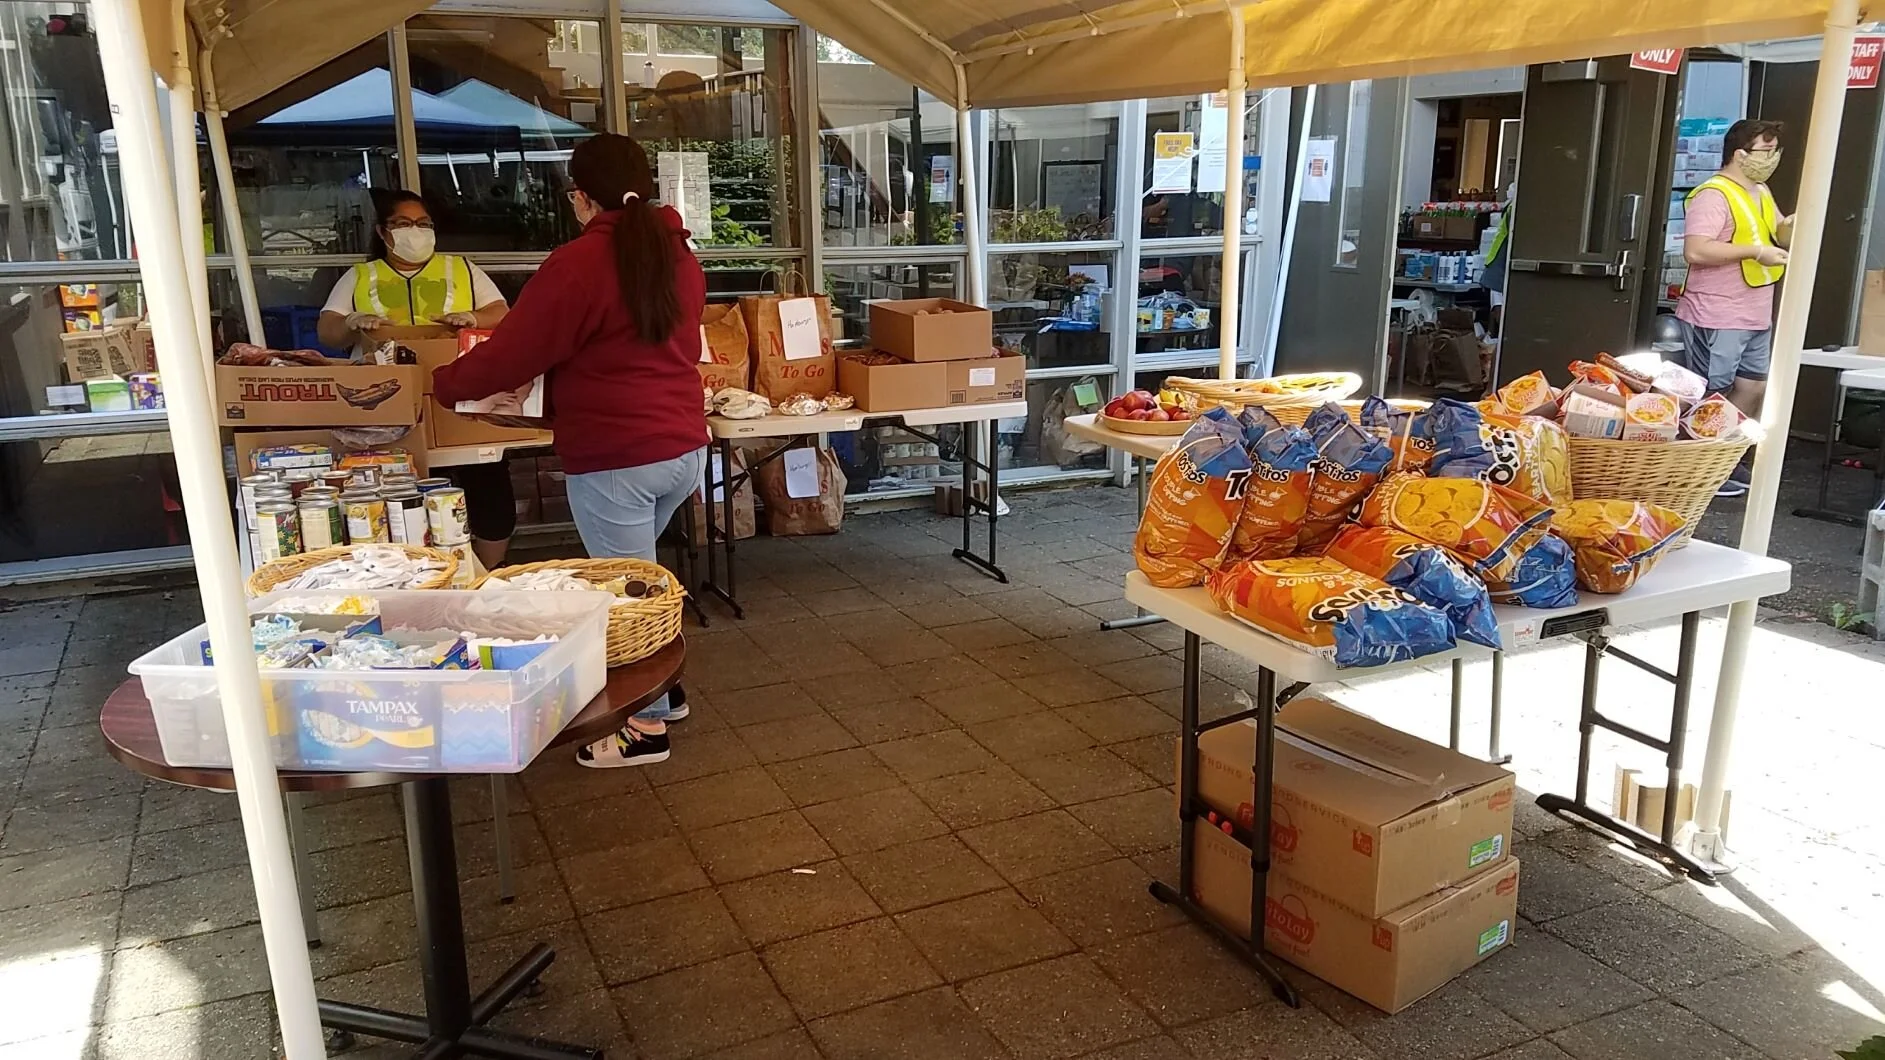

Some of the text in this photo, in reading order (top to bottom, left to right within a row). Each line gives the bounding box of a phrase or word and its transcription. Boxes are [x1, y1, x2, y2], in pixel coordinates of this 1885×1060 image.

[1640, 48, 1674, 64] ONLY
[781, 364, 825, 379] To Go
[703, 374, 725, 388] Go
[241, 384, 337, 402] TROUT
[346, 700, 419, 715] TAMPAX
